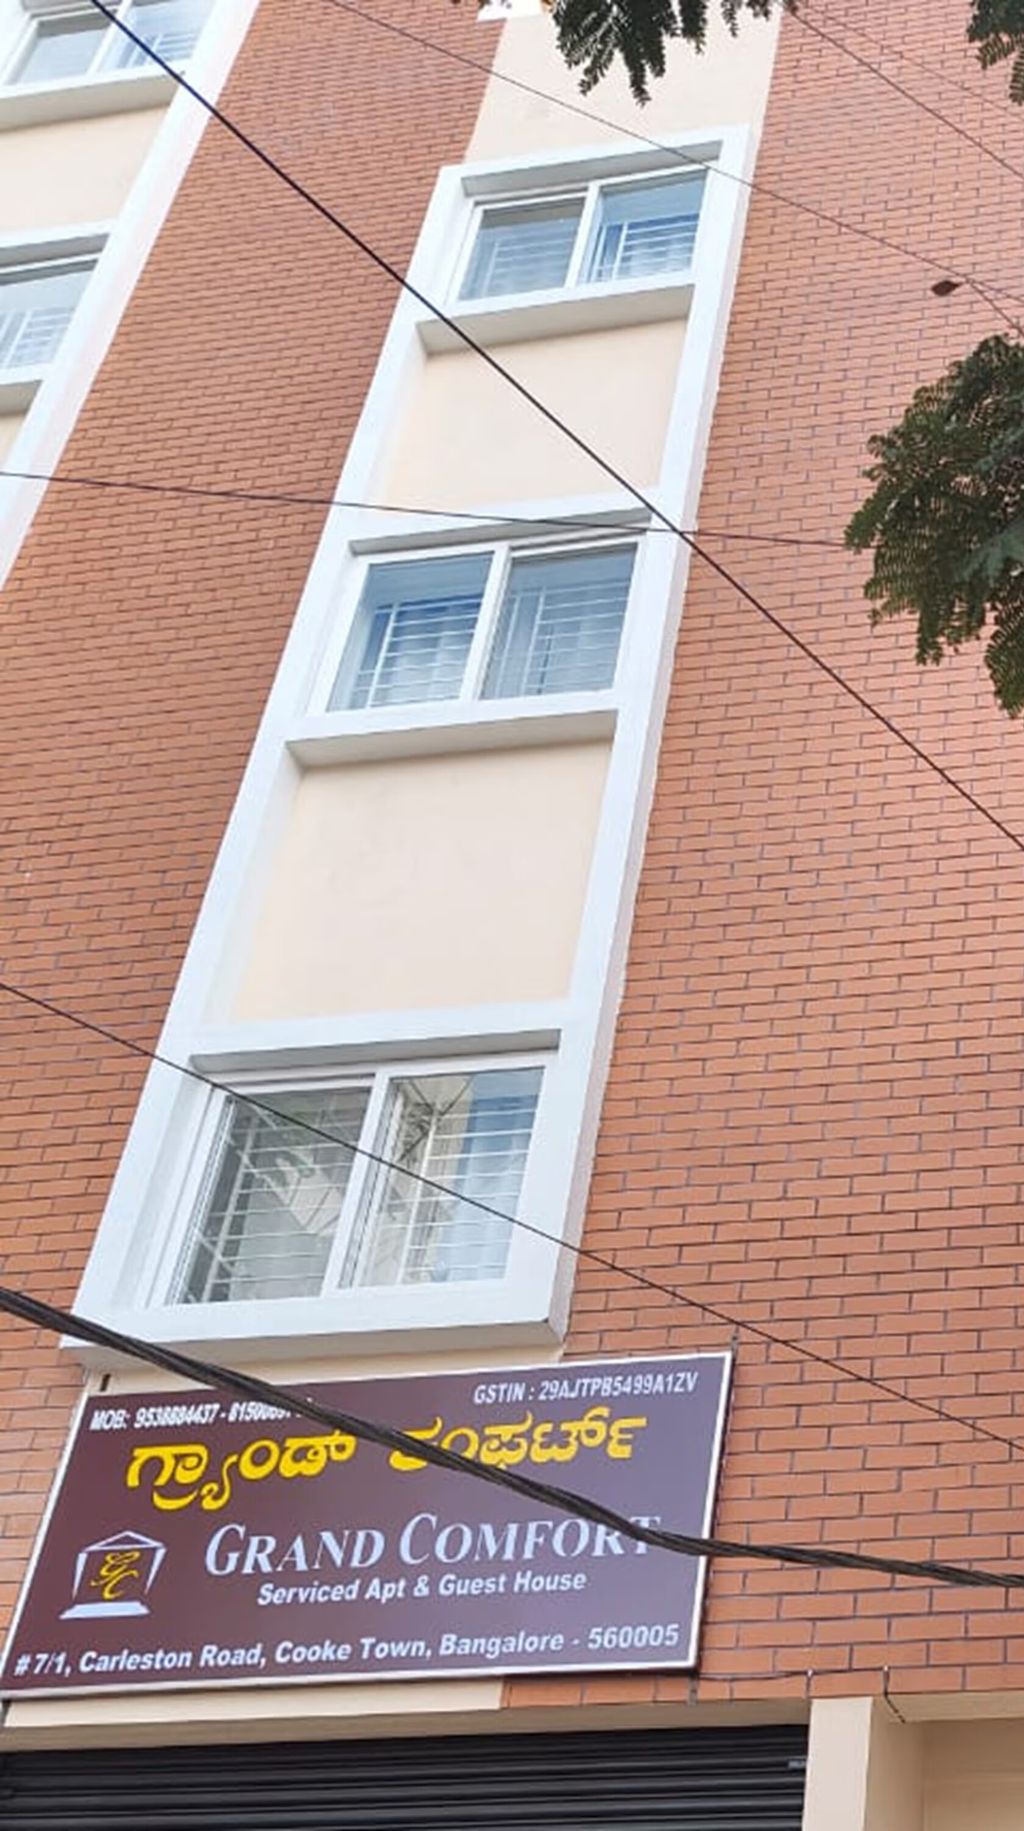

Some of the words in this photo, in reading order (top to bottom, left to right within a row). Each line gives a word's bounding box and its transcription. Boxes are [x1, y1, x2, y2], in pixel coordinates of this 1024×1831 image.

[473, 1382, 525, 1405] GSTIN
[89, 1409, 130, 1430] MOB:
[204, 1523, 386, 1576] GRAND
[400, 1512, 662, 1565] COMFORT
[257, 1579, 361, 1606] Serviced
[364, 1576, 406, 1603] Apt
[413, 1574, 429, 1597] &
[439, 1572, 506, 1596] Guest
[514, 1570, 587, 1593] House
[79, 1648, 192, 1673] Carleston
[199, 1643, 267, 1668] Road,
[275, 1639, 352, 1664] Cooke
[359, 1637, 432, 1660] Town,
[439, 1630, 564, 1659] Bangalore
[587, 1624, 679, 1649] 560005
